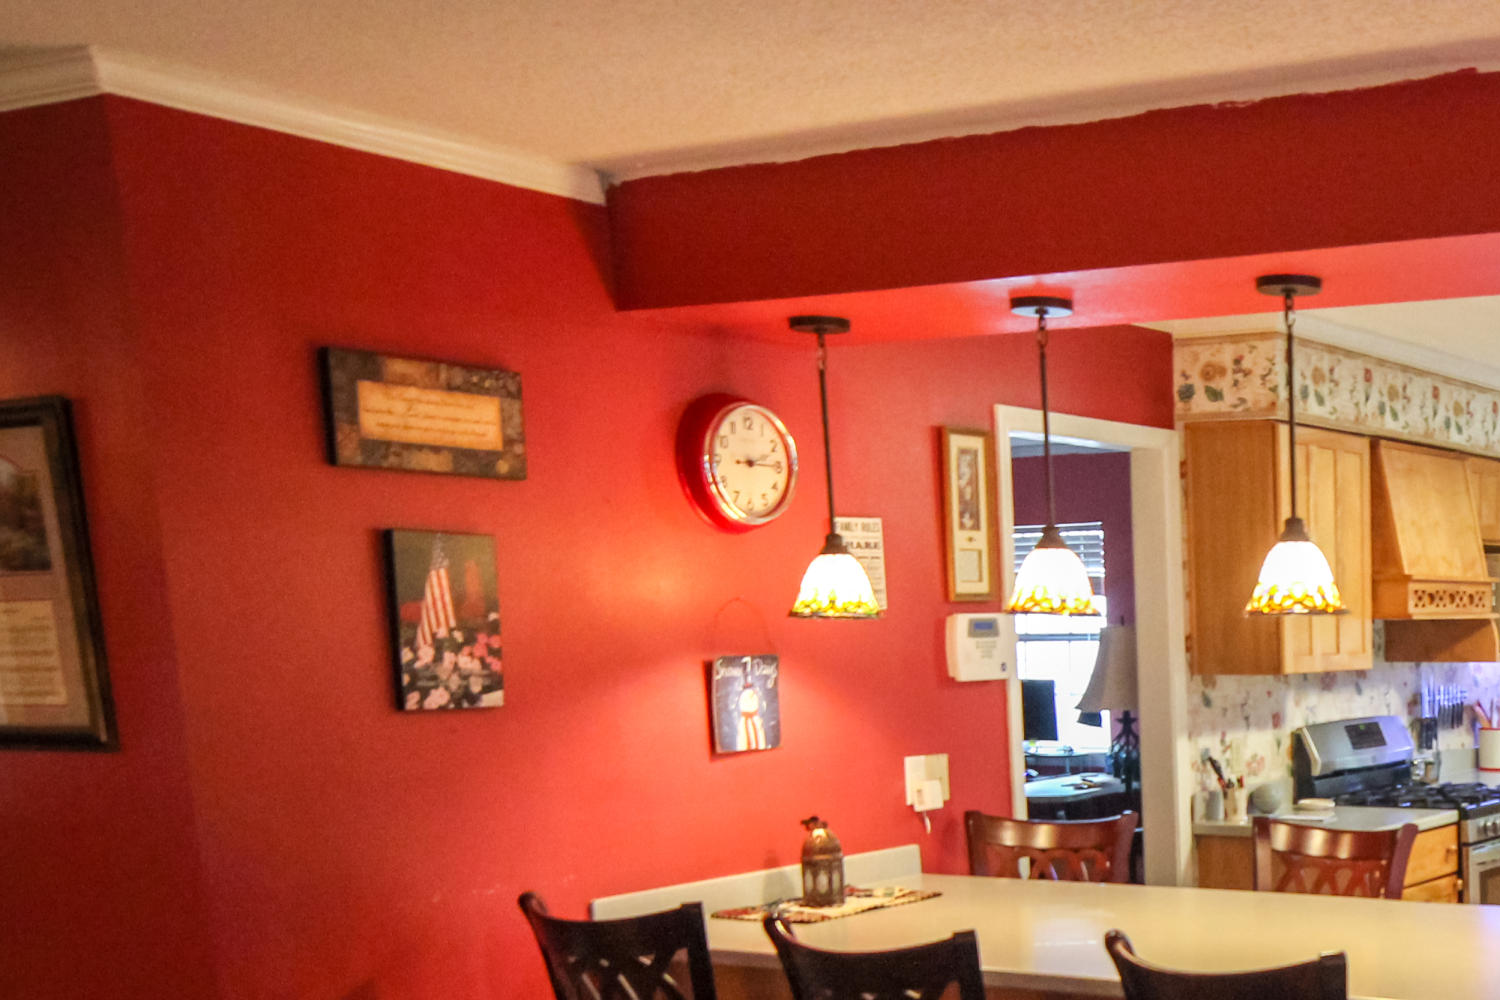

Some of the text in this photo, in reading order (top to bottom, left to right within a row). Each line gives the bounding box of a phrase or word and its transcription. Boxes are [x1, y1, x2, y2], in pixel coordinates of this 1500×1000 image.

[743, 416, 754, 431] 12
[769, 439, 778, 453] 2
[775, 460, 783, 474] 3
[771, 481, 779, 492] 4
[732, 490, 740, 503] 7
[761, 492, 769, 507] 5
[845, 541, 880, 551] HARE
